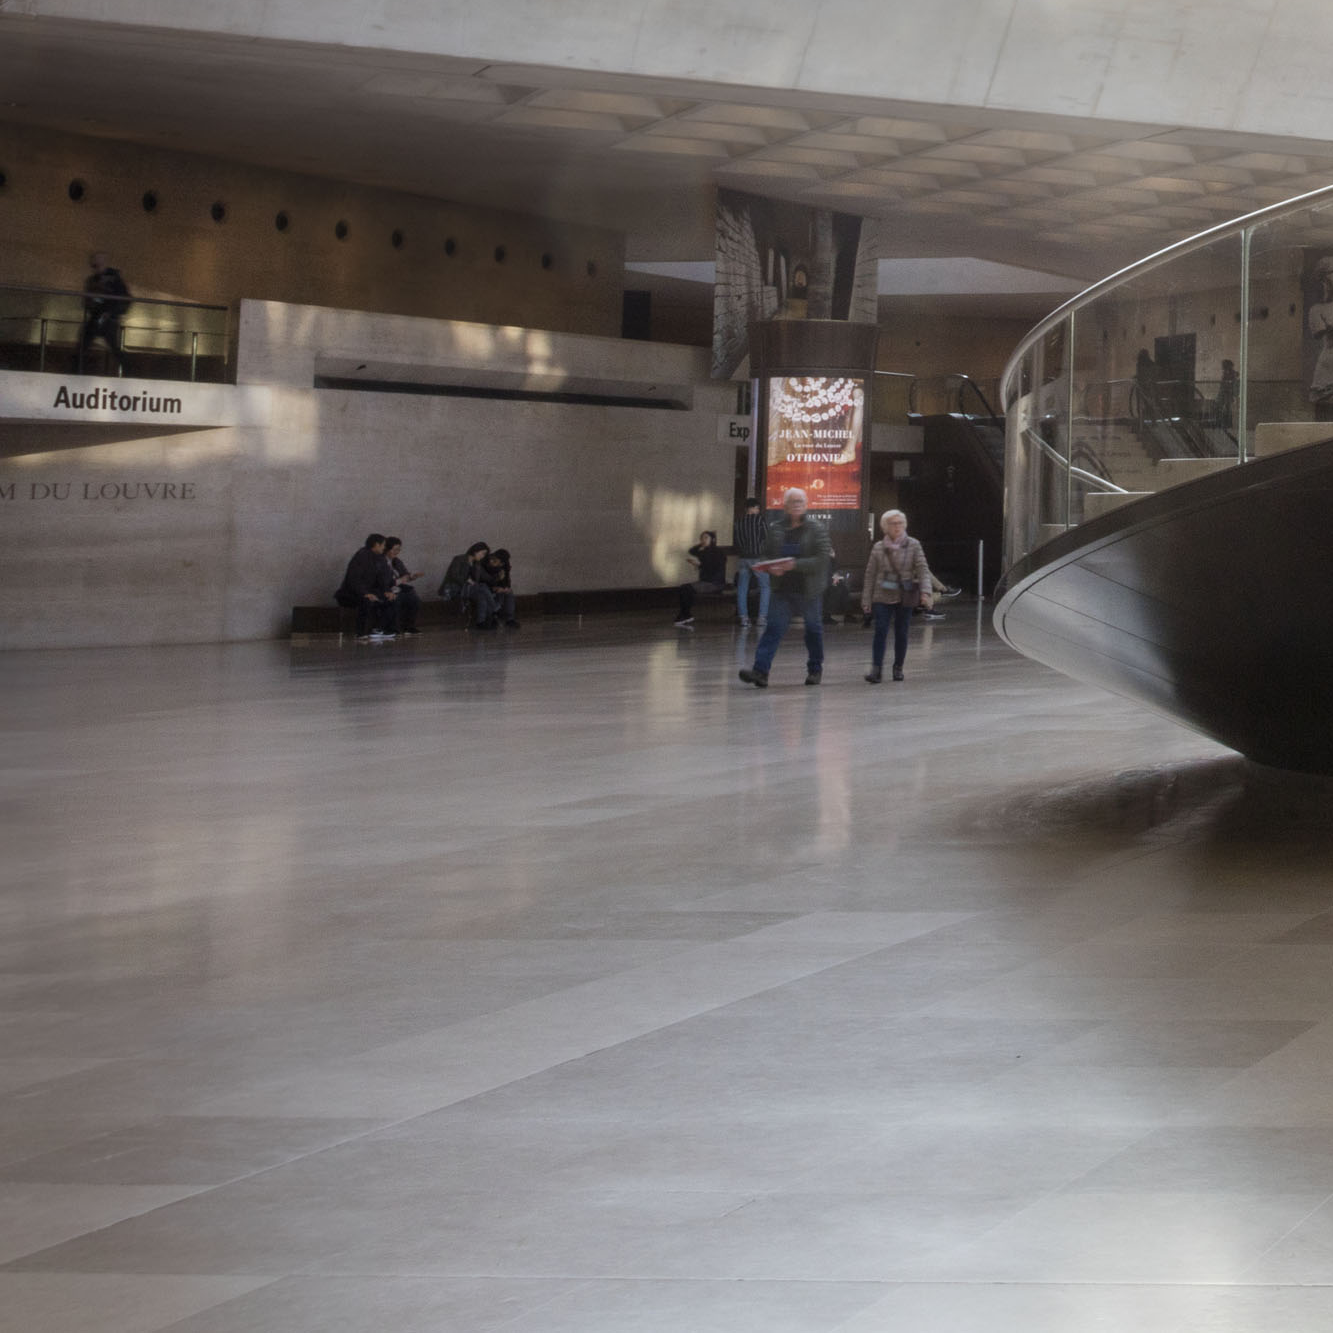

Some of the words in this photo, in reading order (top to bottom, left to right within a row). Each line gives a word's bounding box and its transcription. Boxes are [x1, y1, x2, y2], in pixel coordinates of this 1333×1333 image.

[53, 385, 182, 414] Auditorium
[729, 422, 750, 442] Exp
[779, 429, 854, 439] JEAN-MICHEL
[31, 483, 71, 500] DU
[83, 482, 197, 499] LOUVRE
